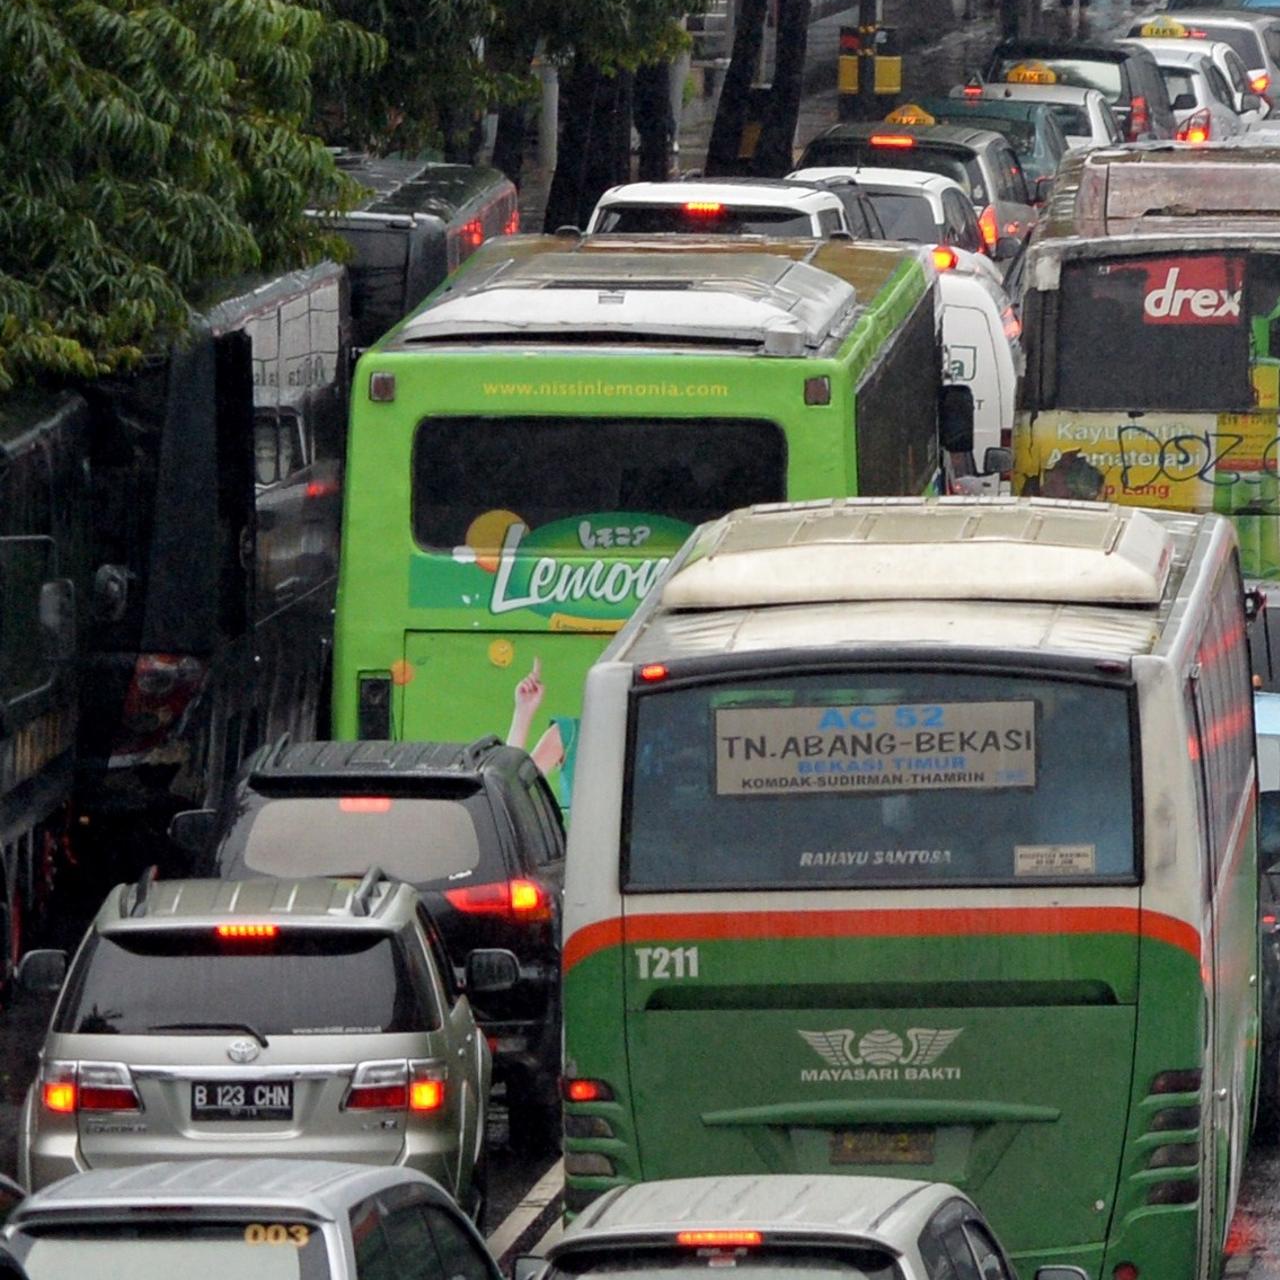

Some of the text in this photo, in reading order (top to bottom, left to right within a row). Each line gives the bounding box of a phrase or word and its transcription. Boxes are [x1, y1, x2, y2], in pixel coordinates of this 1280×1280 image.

[483, 382, 729, 396] www.nissinlemonia.com
[818, 705, 946, 730] AC 52
[722, 729, 1033, 761] TN.ABANG-BEKASI
[796, 755, 967, 774] BEKASI TIMUR
[800, 852, 869, 867] RAHAYU
[635, 946, 699, 979] T211
[801, 1067, 961, 1082] MAYASARI BAKTI
[195, 1084, 290, 1107] B 123 CHN
[244, 1223, 310, 1248] 003
